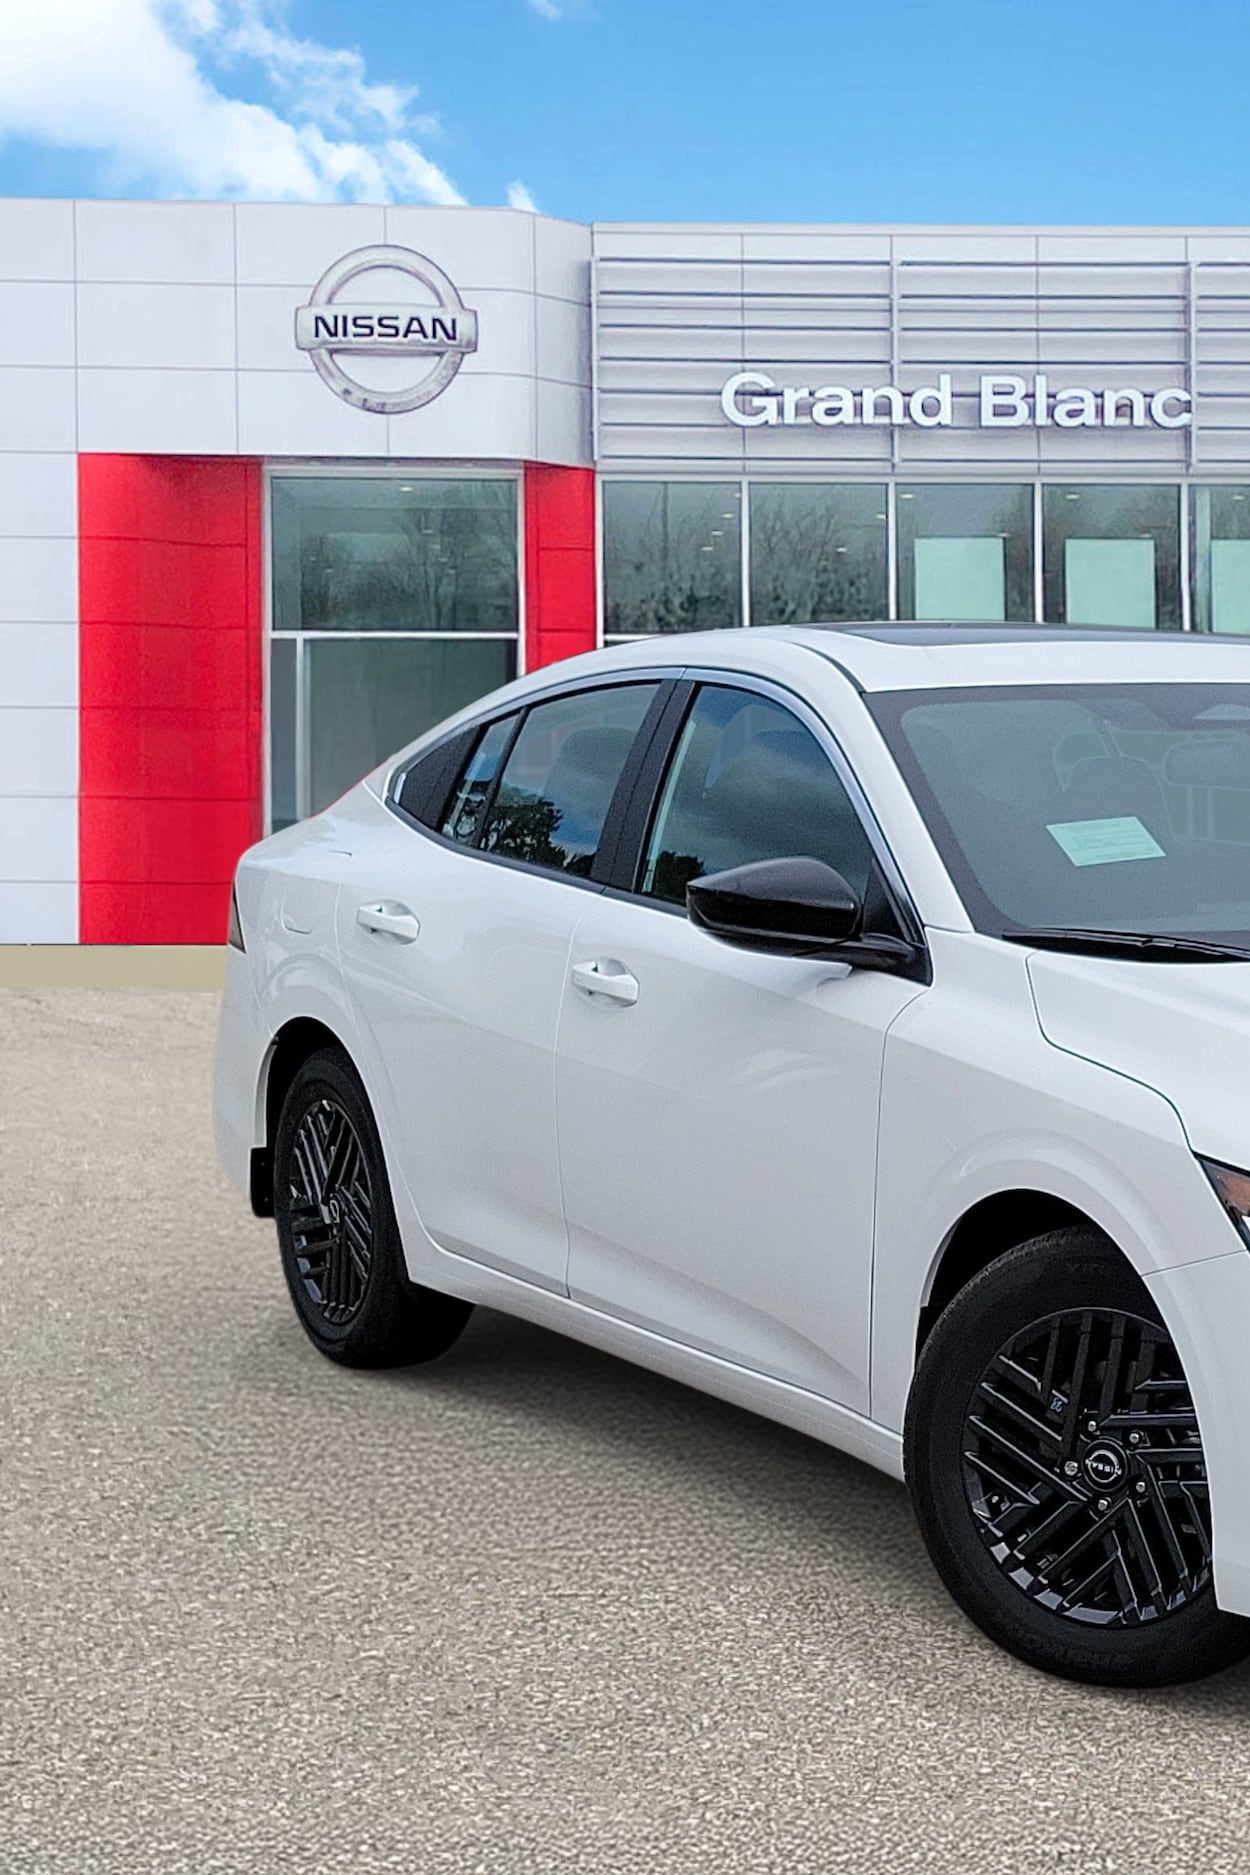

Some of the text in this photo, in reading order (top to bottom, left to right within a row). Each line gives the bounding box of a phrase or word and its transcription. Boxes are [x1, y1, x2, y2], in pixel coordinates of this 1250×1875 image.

[314, 315, 457, 341] NISSAN
[720, 371, 1193, 428] Grand Blanc
